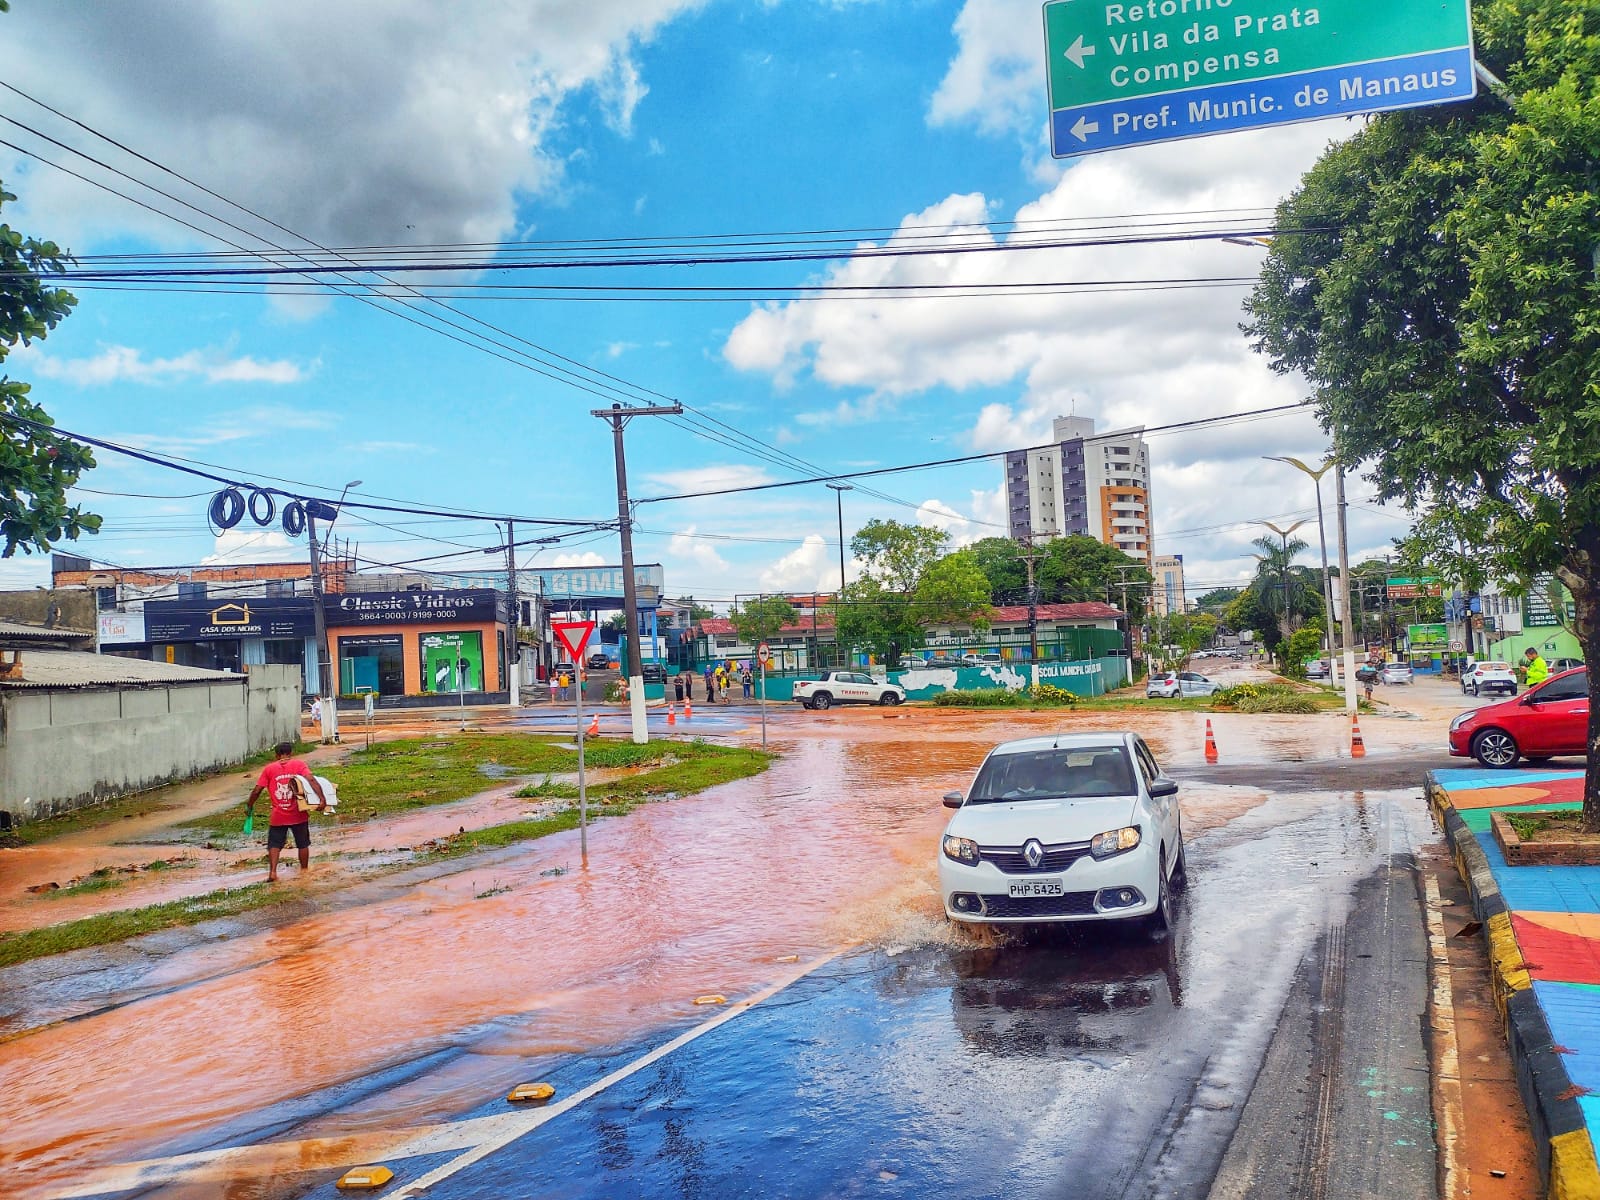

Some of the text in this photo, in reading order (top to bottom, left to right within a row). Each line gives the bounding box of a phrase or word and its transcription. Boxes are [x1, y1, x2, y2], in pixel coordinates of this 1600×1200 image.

[1109, 8, 1320, 56] Vila da Prata
[1110, 46, 1280, 87] Compensa
[1112, 67, 1457, 134] Pref. Munic. de Manaus
[340, 594, 474, 611] Classic Vidros
[200, 626, 219, 634] CASA
[1038, 666, 1059, 677] SCOLA
[1010, 884, 1061, 895] PHP-6425
